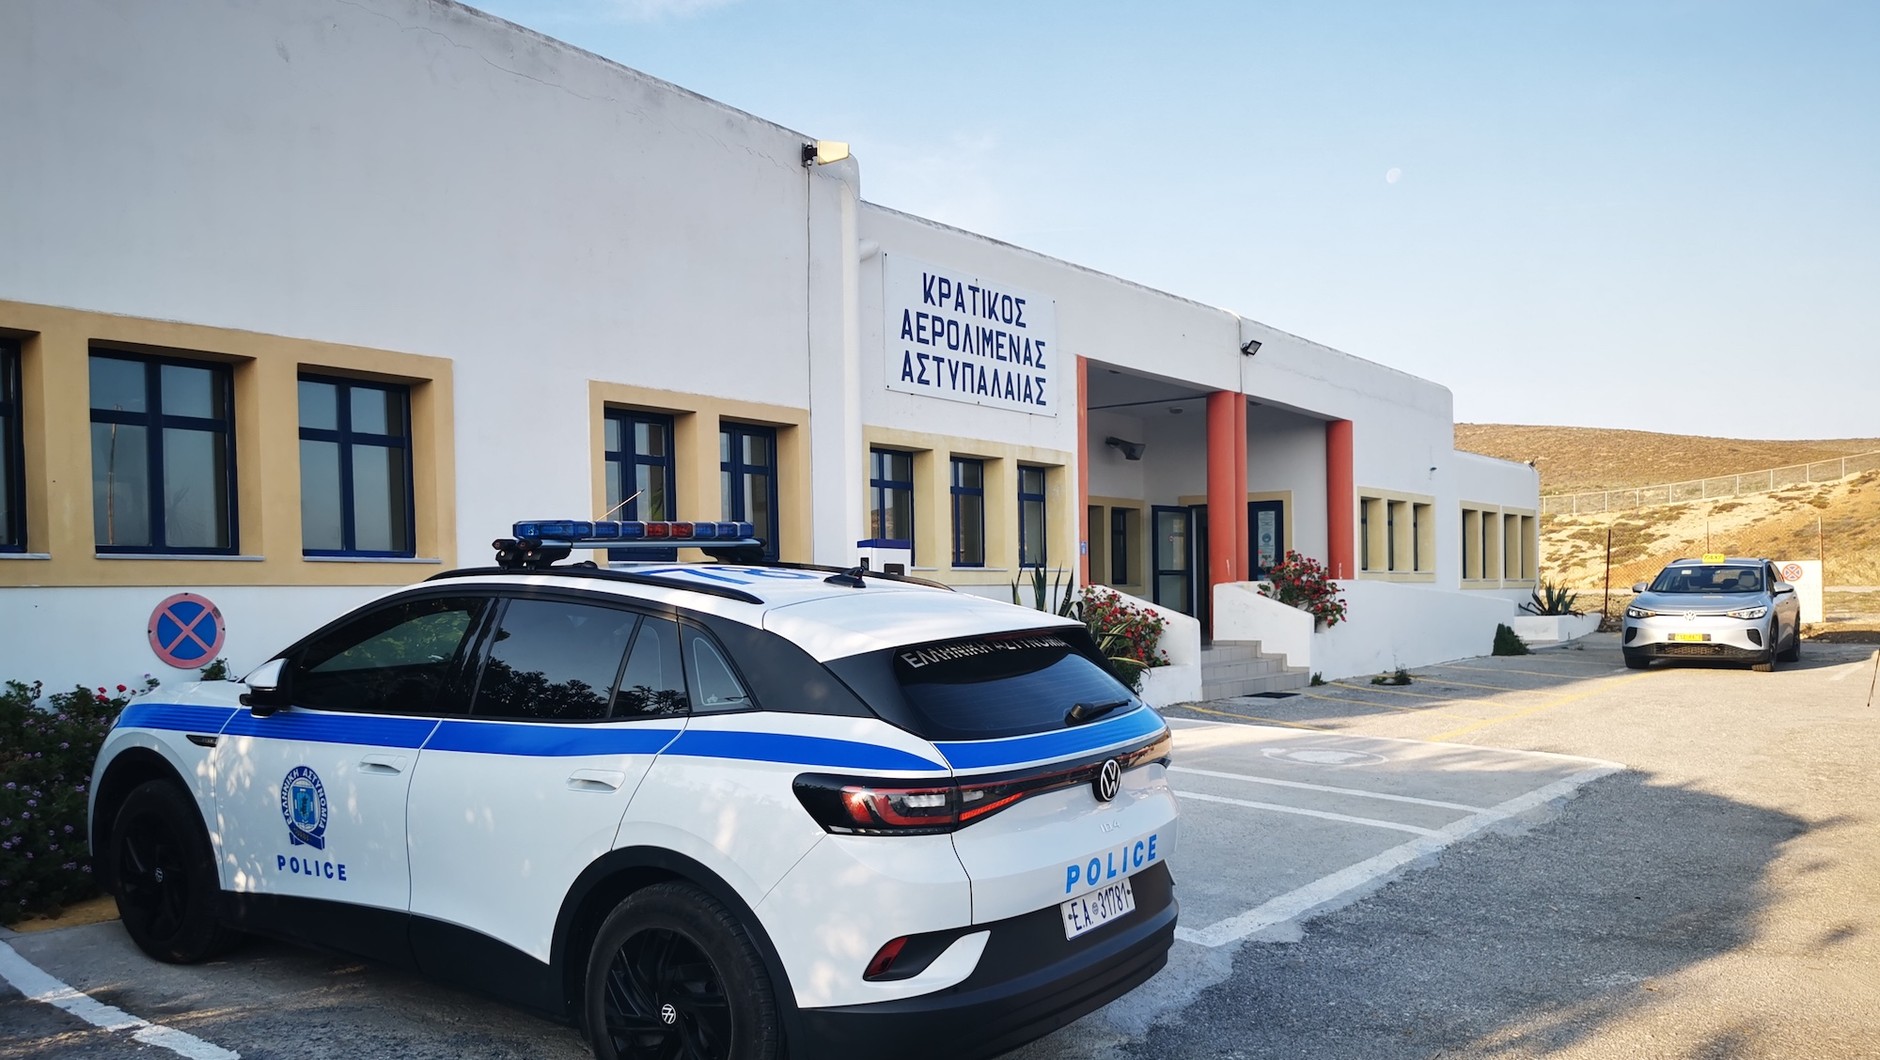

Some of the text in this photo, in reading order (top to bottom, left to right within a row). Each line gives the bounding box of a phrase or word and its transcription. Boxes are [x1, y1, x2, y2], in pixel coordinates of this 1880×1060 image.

[922, 272, 1027, 328] ΚΡΑΤΙΚΟΣ
[900, 308, 1047, 370] ΑΕΡΟΛΙΜΕΝΑΣ
[900, 349, 1047, 406] ΑΣΤΥΠΑΛΑΙΑΣ
[277, 854, 347, 881] POLICE
[1065, 834, 1158, 894] POLICE
[1097, 882, 1129, 919] 31781
